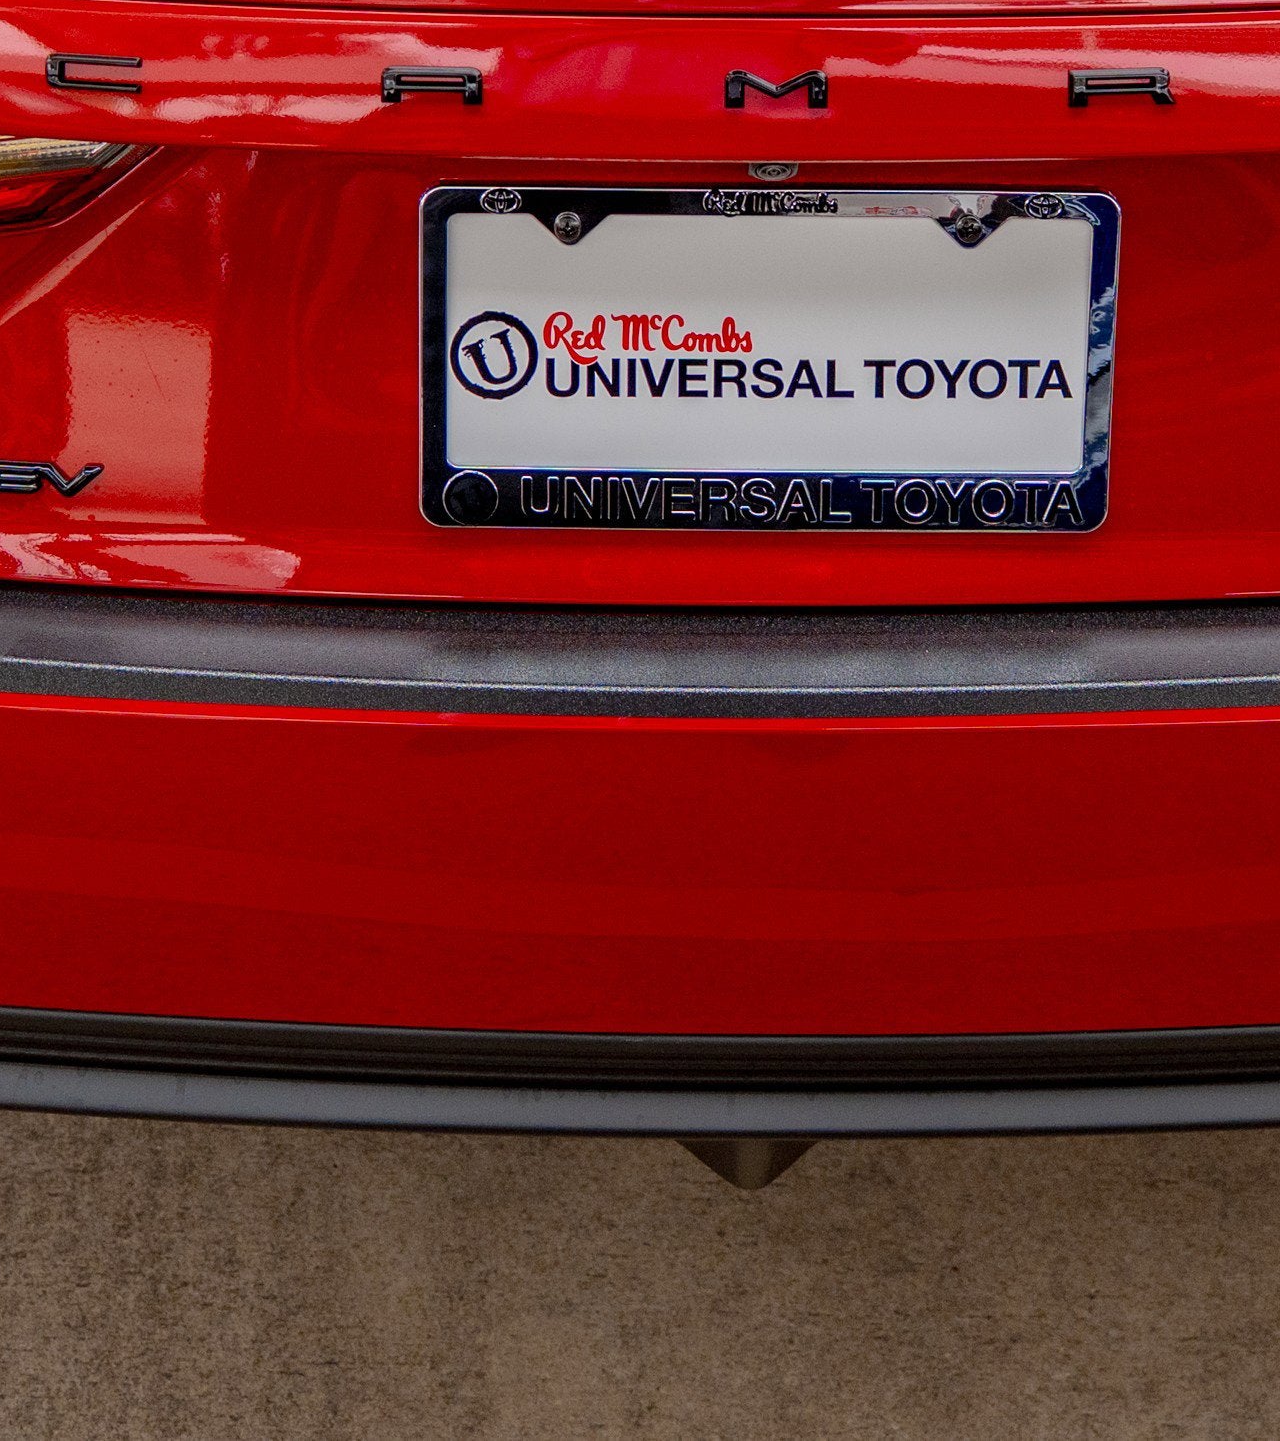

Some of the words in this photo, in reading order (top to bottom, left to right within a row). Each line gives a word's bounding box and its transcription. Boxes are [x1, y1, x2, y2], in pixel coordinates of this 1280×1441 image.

[542, 311, 607, 365] Red
[610, 313, 753, 354] McCombs
[545, 357, 856, 400] UNIVERSAL
[863, 358, 1074, 400] TOYOTA
[520, 475, 853, 523] UNIVERSAL
[859, 478, 1086, 526] TOYOTA
